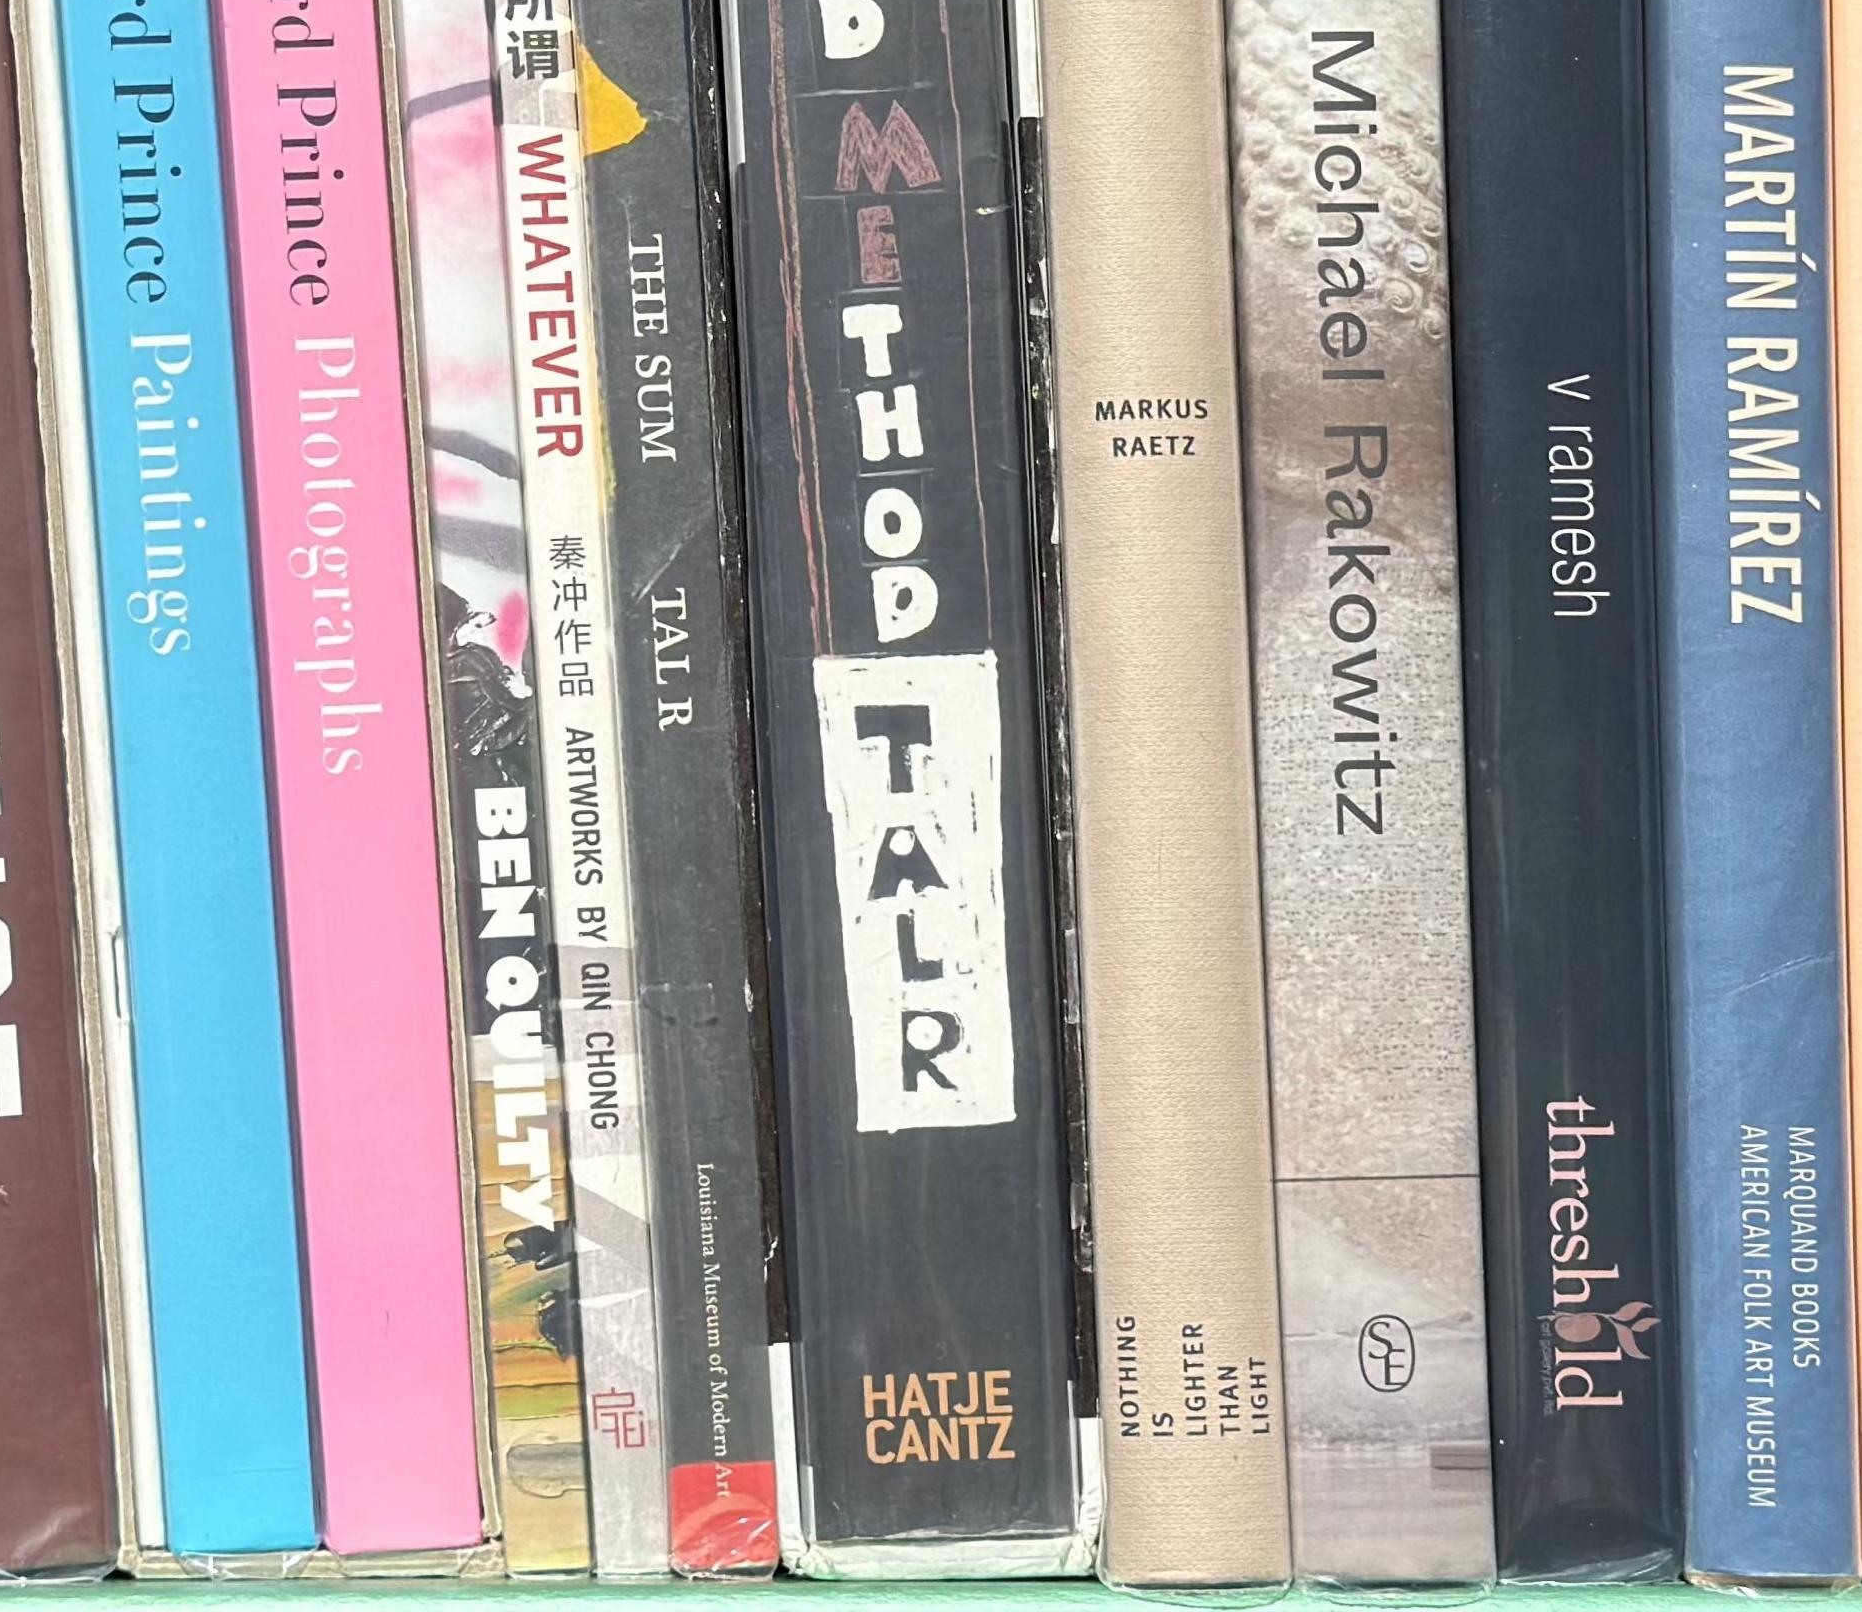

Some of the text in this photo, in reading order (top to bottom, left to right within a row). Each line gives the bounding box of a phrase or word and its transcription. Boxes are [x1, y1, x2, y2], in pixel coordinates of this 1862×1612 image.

[109, 77, 184, 304] Prince
[274, 82, 345, 306] Prince
[517, 133, 584, 459] WHATEVER
[834, 98, 941, 644] METHOD
[1095, 398, 1209, 422] MARKUS
[1112, 435, 1196, 458] RAETZ
[1311, 30, 1399, 836] Michael Rakowitz
[1723, 64, 1822, 625] MARTÍN RAMÍREZ
[127, 331, 207, 656] Paintings
[288, 334, 384, 774] Photographs
[626, 233, 693, 731] THE SUM TAL R
[1547, 374, 1612, 617] v ramesh
[549, 536, 595, 697] 秦冲作品
[474, 787, 556, 1232] BEN QUILTY
[563, 726, 620, 1131] ARTWORKS BY QIN CHONG
[696, 1162, 733, 1497] Louisiana Museum of Modern Art
[1738, 1124, 1778, 1509] AMERICAN FOLK ART MUSEUM
[1782, 1125, 1821, 1369] MARQUAND BOOKS
[862, 1369, 1013, 1418] HATJE
[864, 1414, 1016, 1464] CANTZ
[1116, 1316, 1141, 1437] NOTHING
[1151, 1412, 1174, 1437] IS
[1182, 1323, 1208, 1437] LIGHTER
[1217, 1365, 1242, 1437] THAN
[1249, 1356, 1271, 1435] LIGHT
